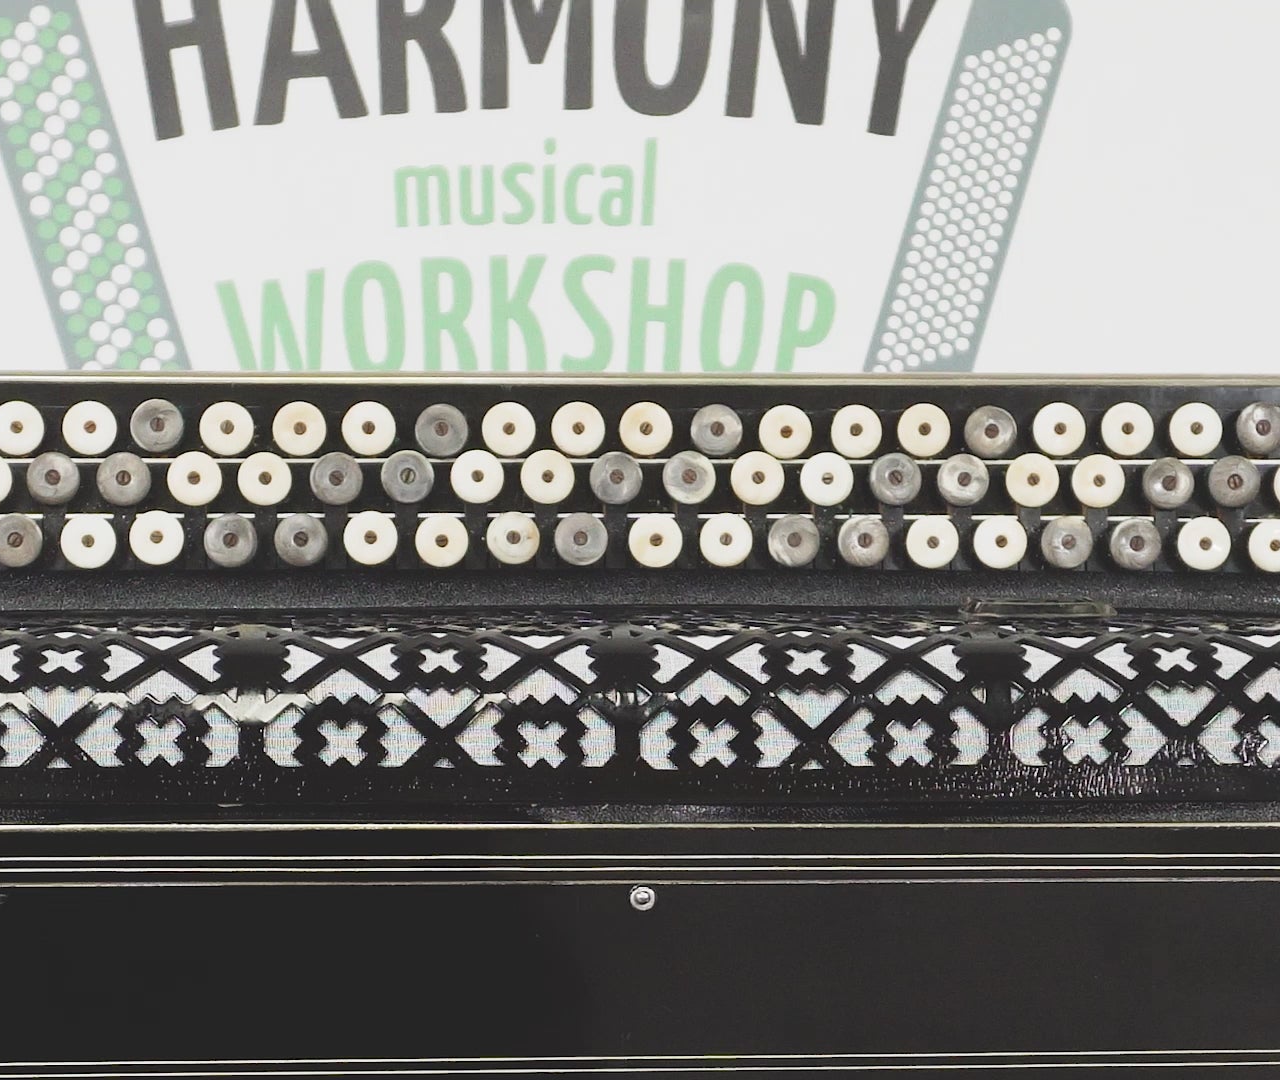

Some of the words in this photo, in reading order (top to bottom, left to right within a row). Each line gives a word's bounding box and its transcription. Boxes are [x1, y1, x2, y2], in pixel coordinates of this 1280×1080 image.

[134, 0, 935, 141] HARMONY
[393, 139, 657, 228] musical
[216, 254, 835, 371] WORKSHOP
